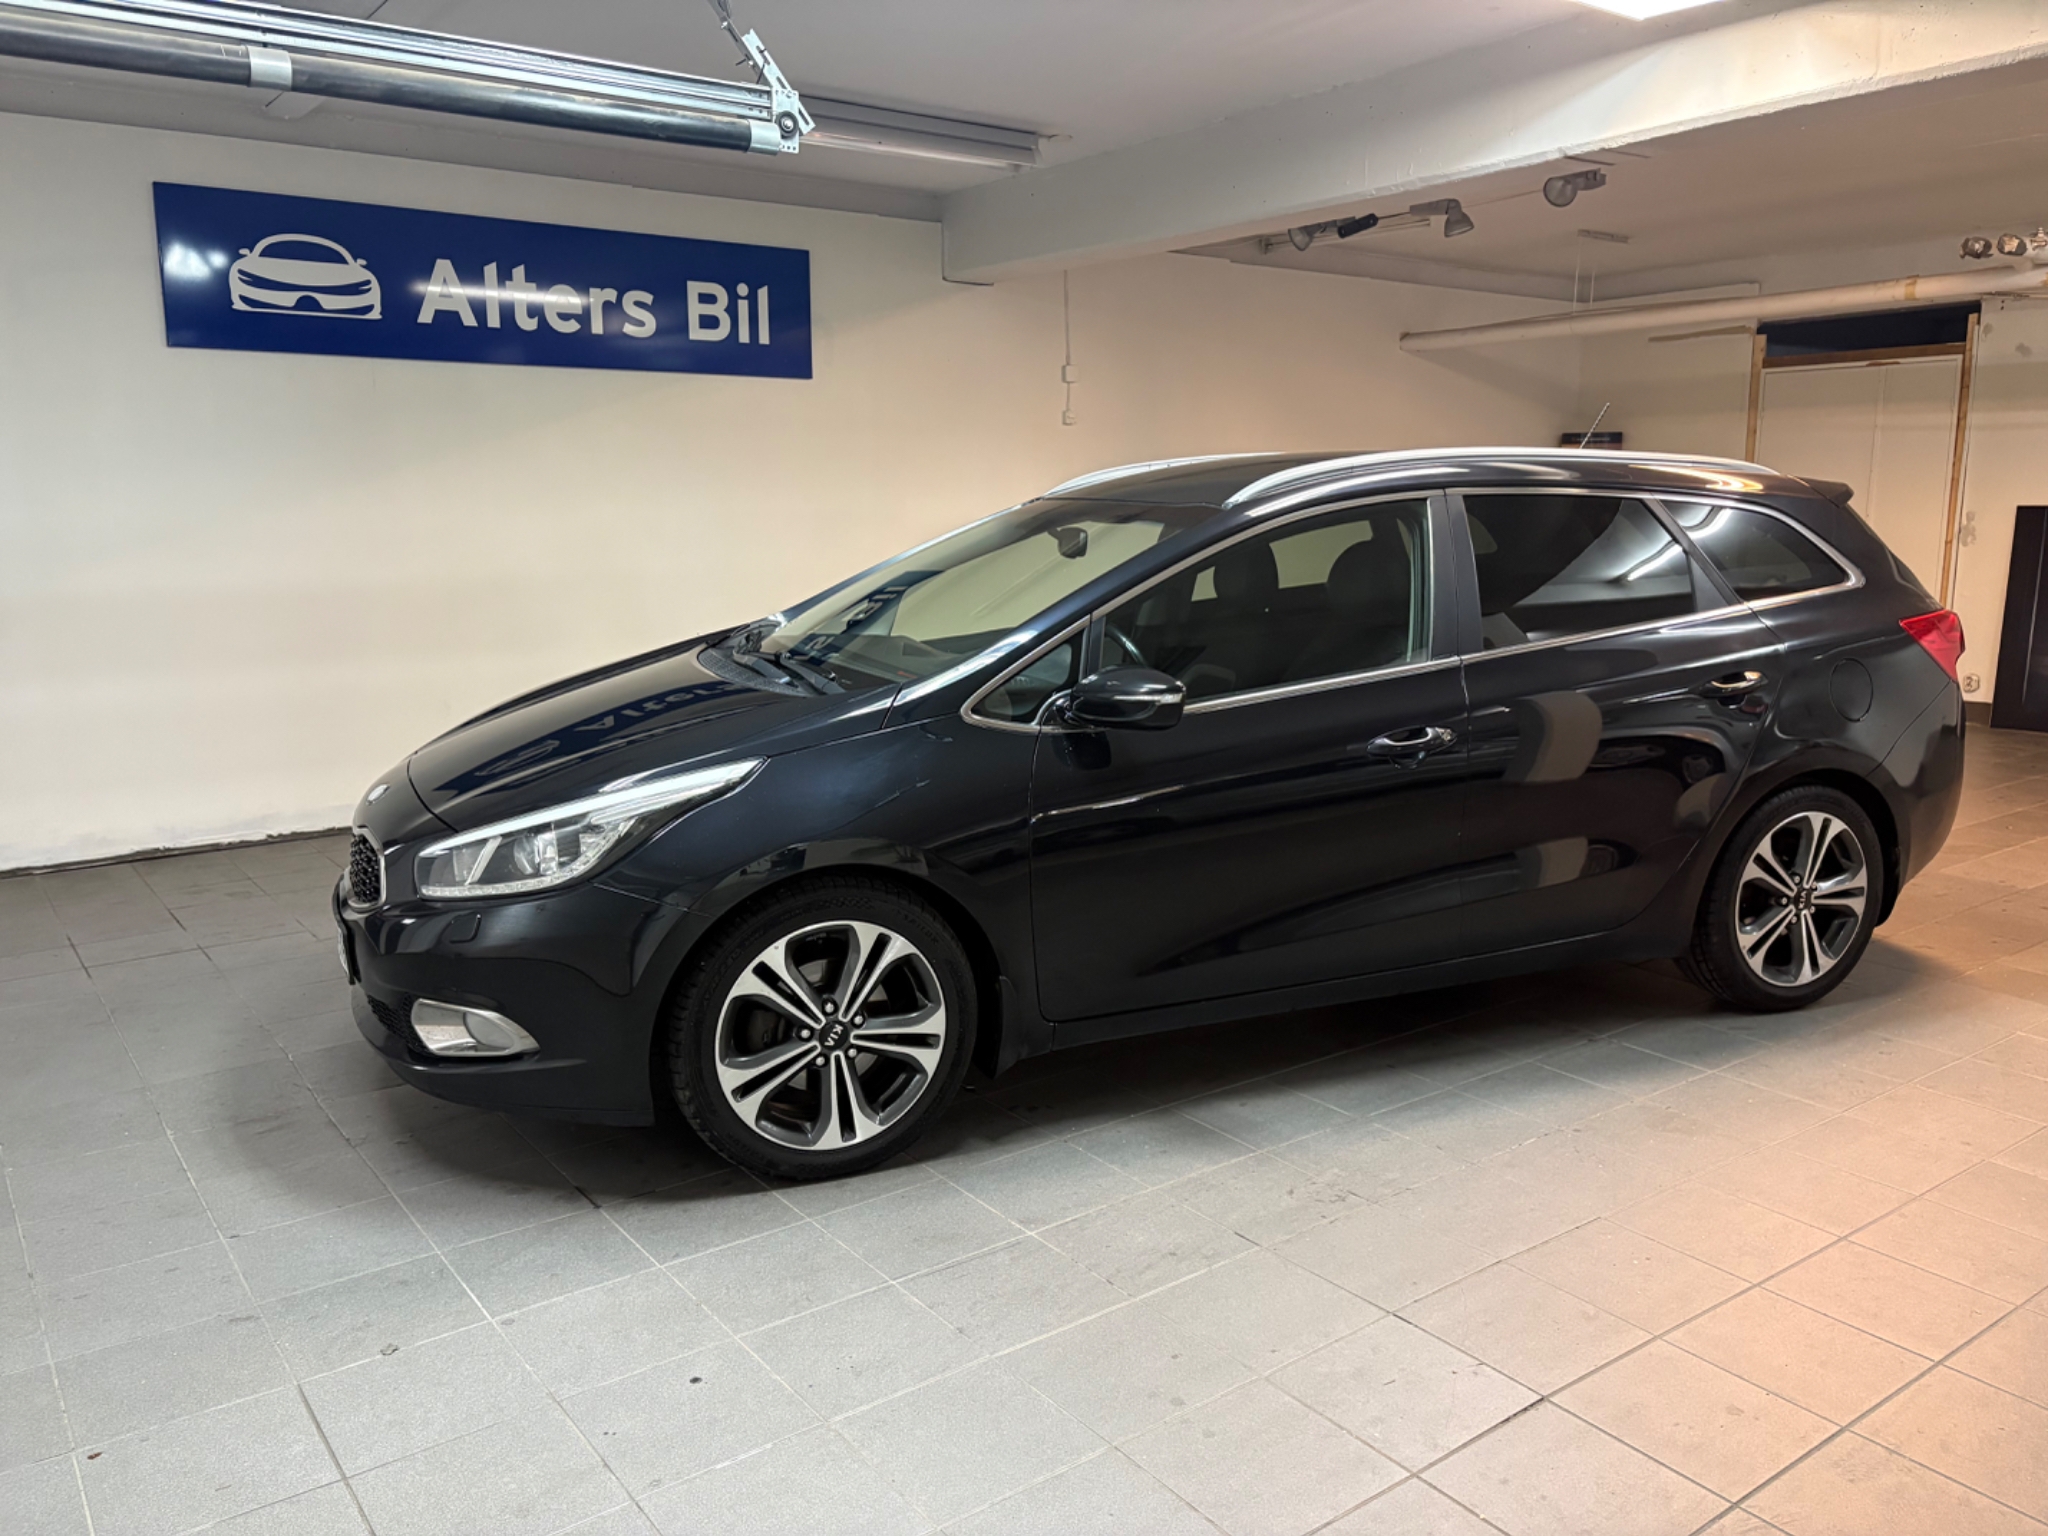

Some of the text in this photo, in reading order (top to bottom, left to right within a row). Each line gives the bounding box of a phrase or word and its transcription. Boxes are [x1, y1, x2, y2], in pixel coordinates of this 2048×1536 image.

[416, 258, 770, 345] Alters Bil
[824, 1024, 844, 1046] KIA
